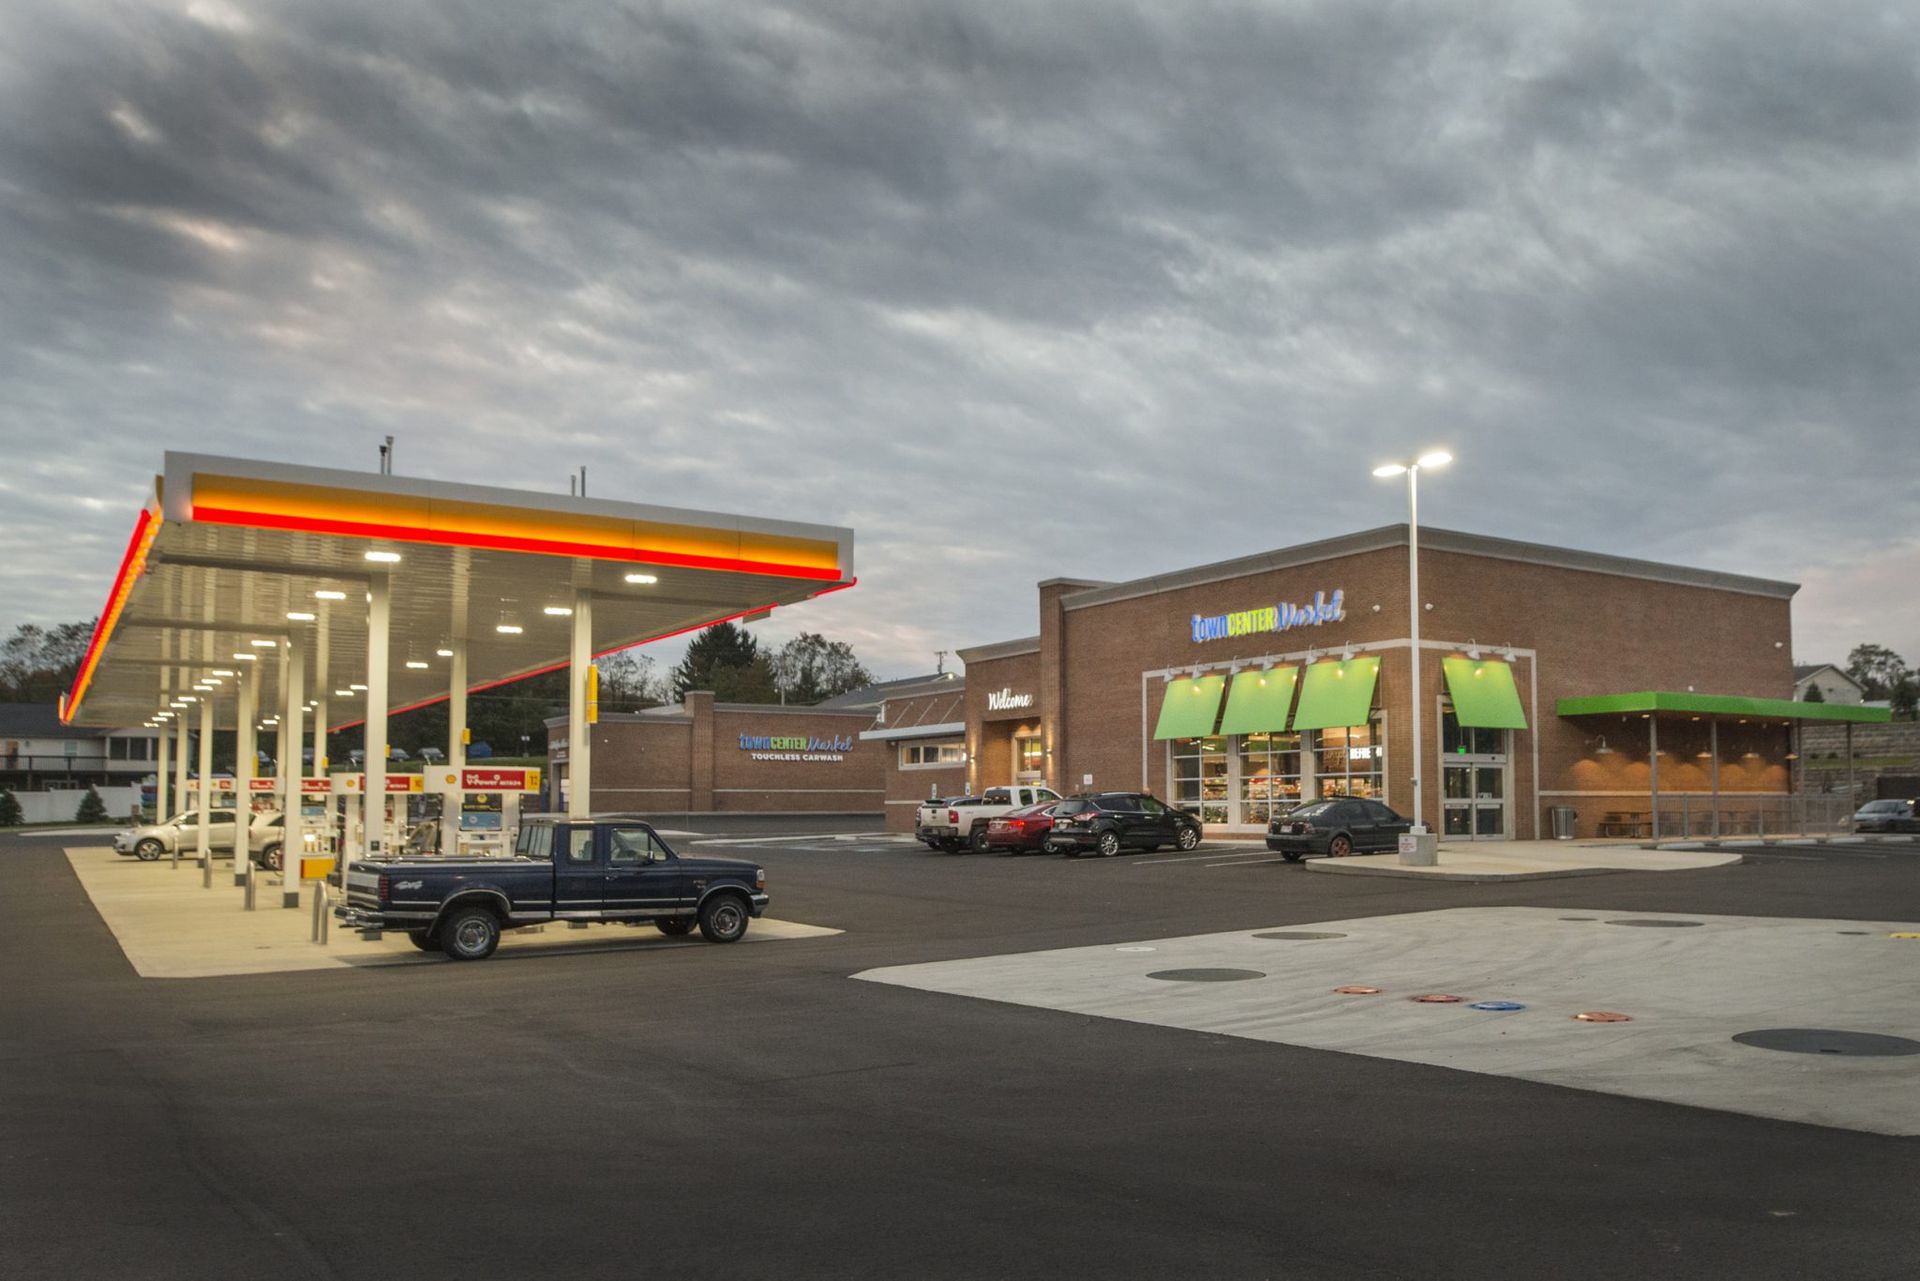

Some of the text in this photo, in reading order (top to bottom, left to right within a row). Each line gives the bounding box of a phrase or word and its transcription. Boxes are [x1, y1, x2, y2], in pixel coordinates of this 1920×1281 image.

[988, 688, 1033, 711] Welcome
[751, 753, 843, 762] TOUCHLESS CARWASH
